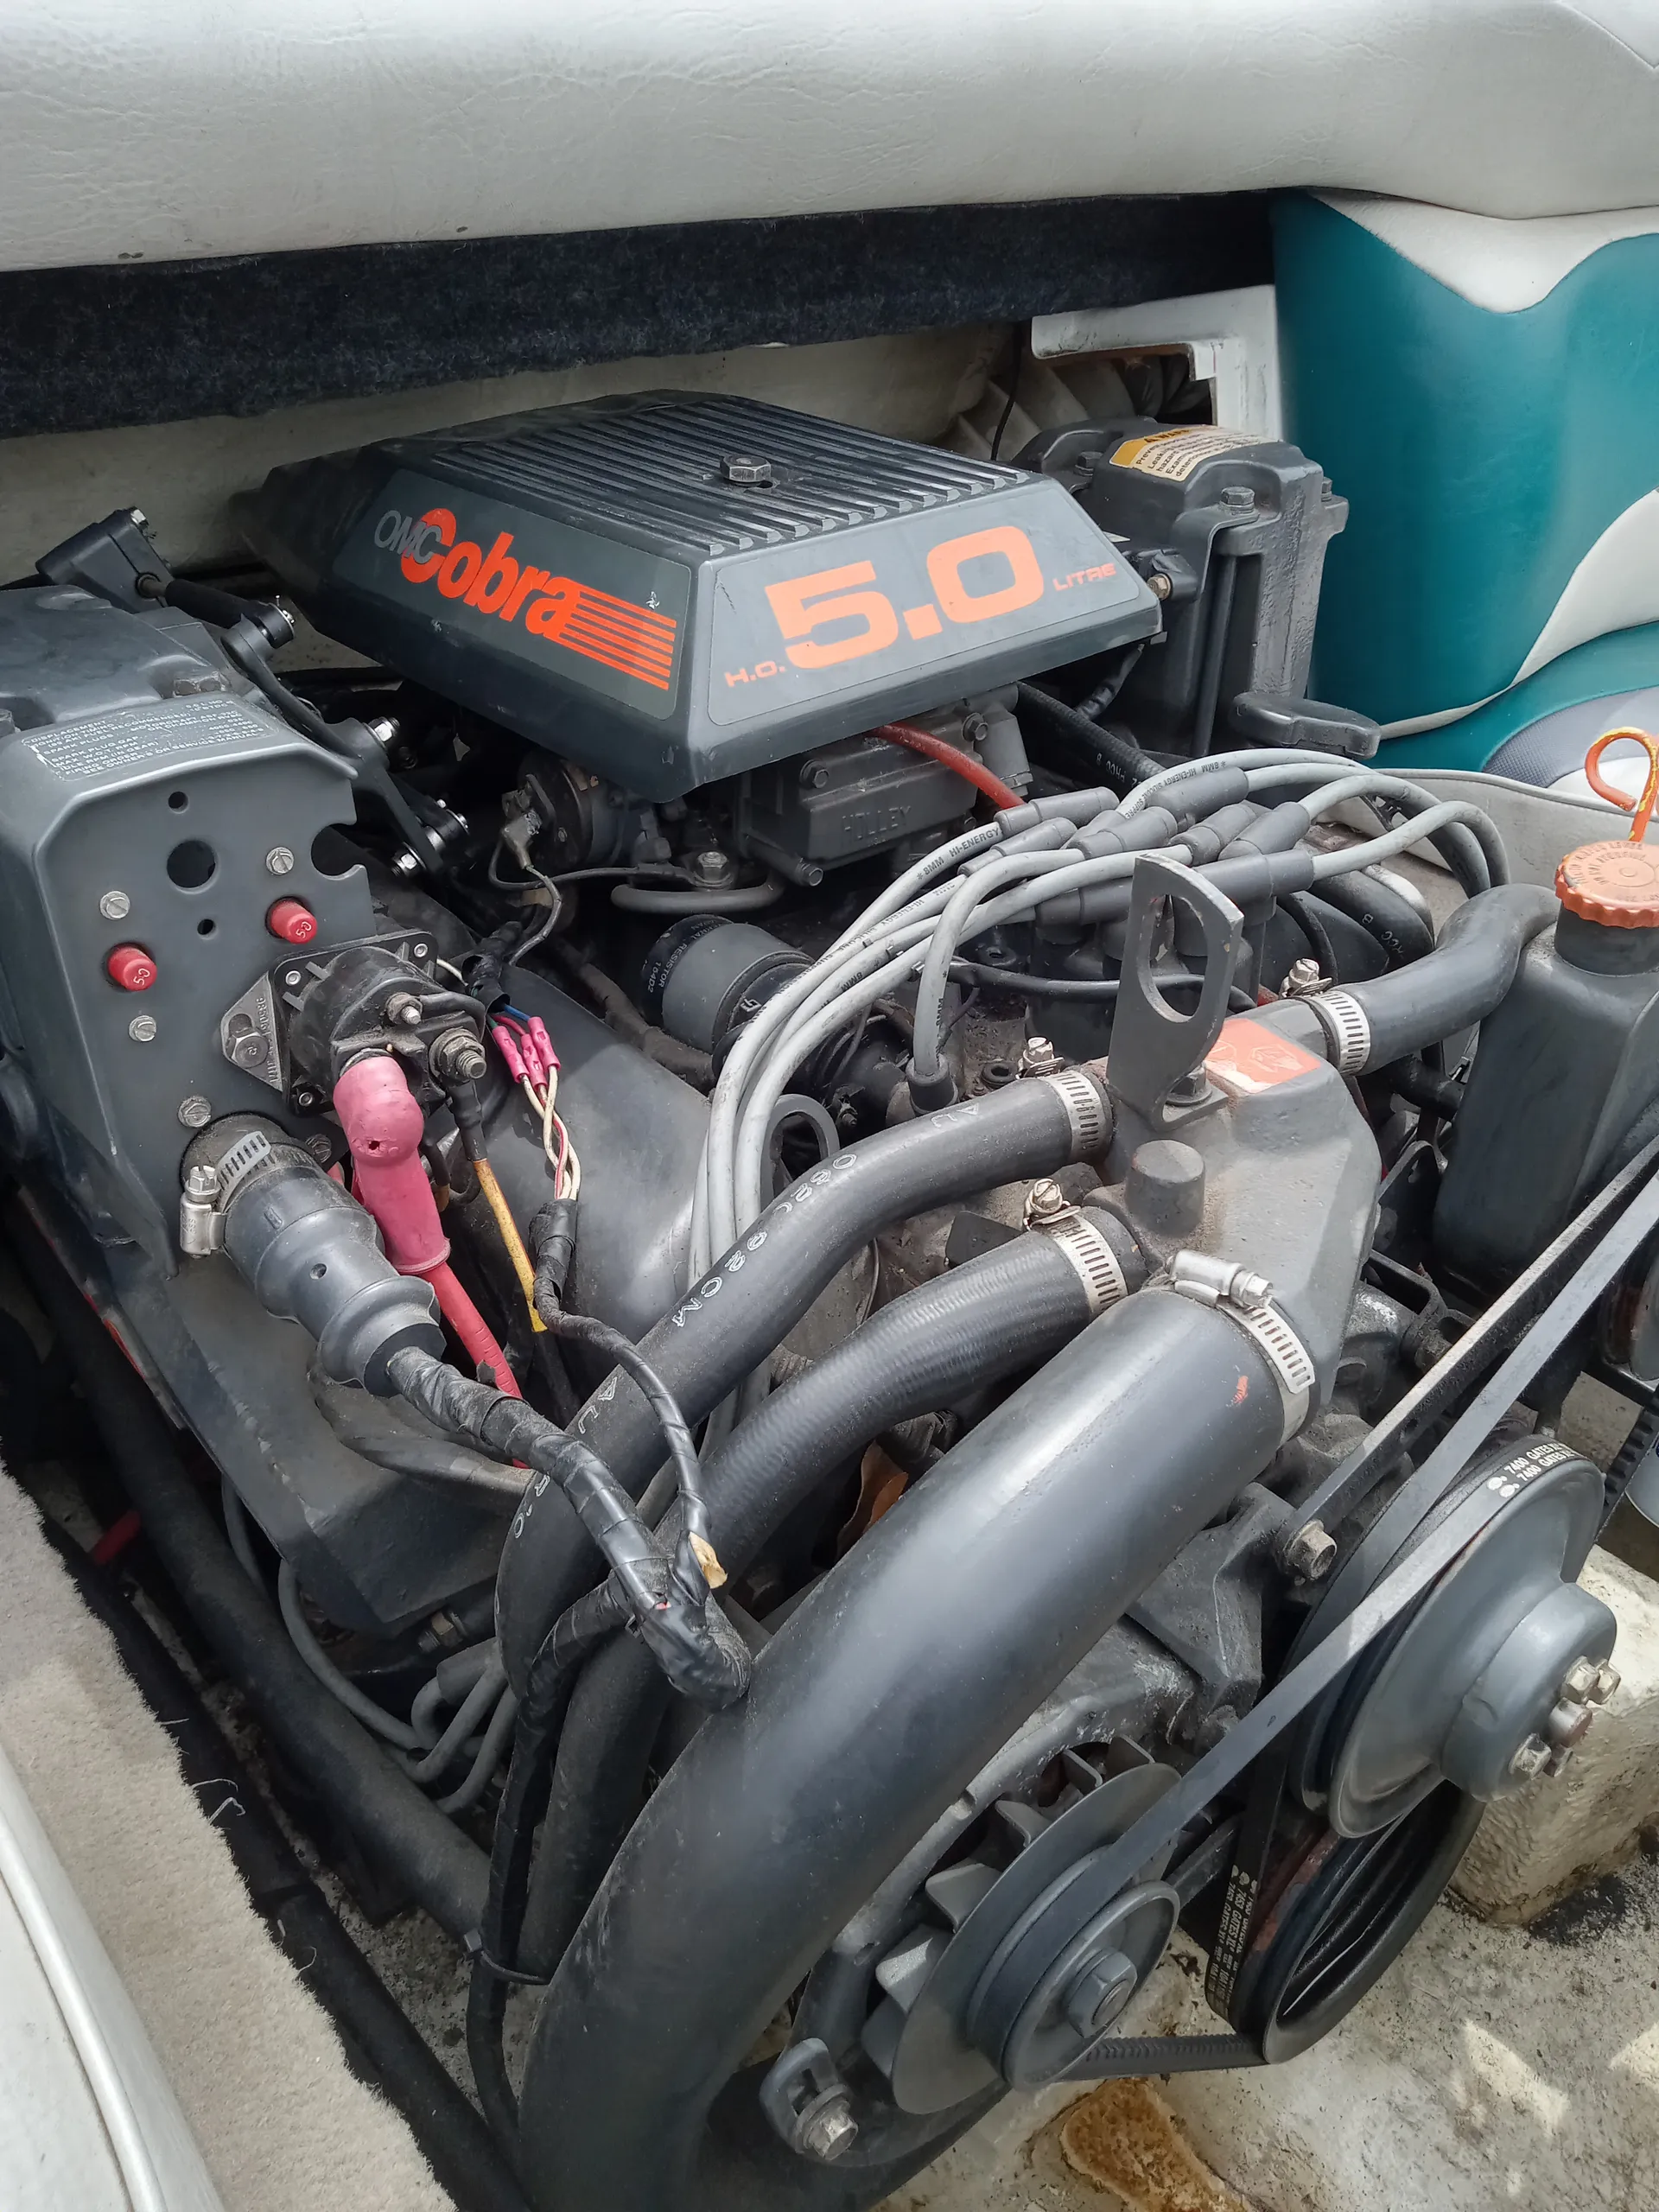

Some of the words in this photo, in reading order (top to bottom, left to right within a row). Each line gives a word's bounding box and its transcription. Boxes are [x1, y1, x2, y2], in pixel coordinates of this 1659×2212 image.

[374, 510, 442, 564] OMC
[401, 508, 582, 641] Cobra
[724, 659, 786, 688] H.O.
[765, 525, 1044, 670] 5.0
[1052, 563, 1117, 592] LITRE
[43, 743, 79, 755] SPARK
[79, 733, 114, 745] PLUGS
[51, 750, 86, 762] SPARK
[87, 742, 117, 753] PLUG
[118, 735, 139, 744] GAP
[102, 752, 138, 764] ORDER
[55, 757, 79, 767] MAX
[82, 766, 105, 774] SEE
[922, 855, 944, 876] 8MM
[949, 826, 1000, 858] HI-ENERGY
[658, 943, 688, 988] RESISTOR
[1503, 1457, 1530, 1475] 7400
[1526, 1443, 1554, 1459] GATES
[1516, 1464, 1541, 1482] 7400
[1537, 1452, 1567, 1468] GATES
[1228, 1910, 1243, 1938] GATES
